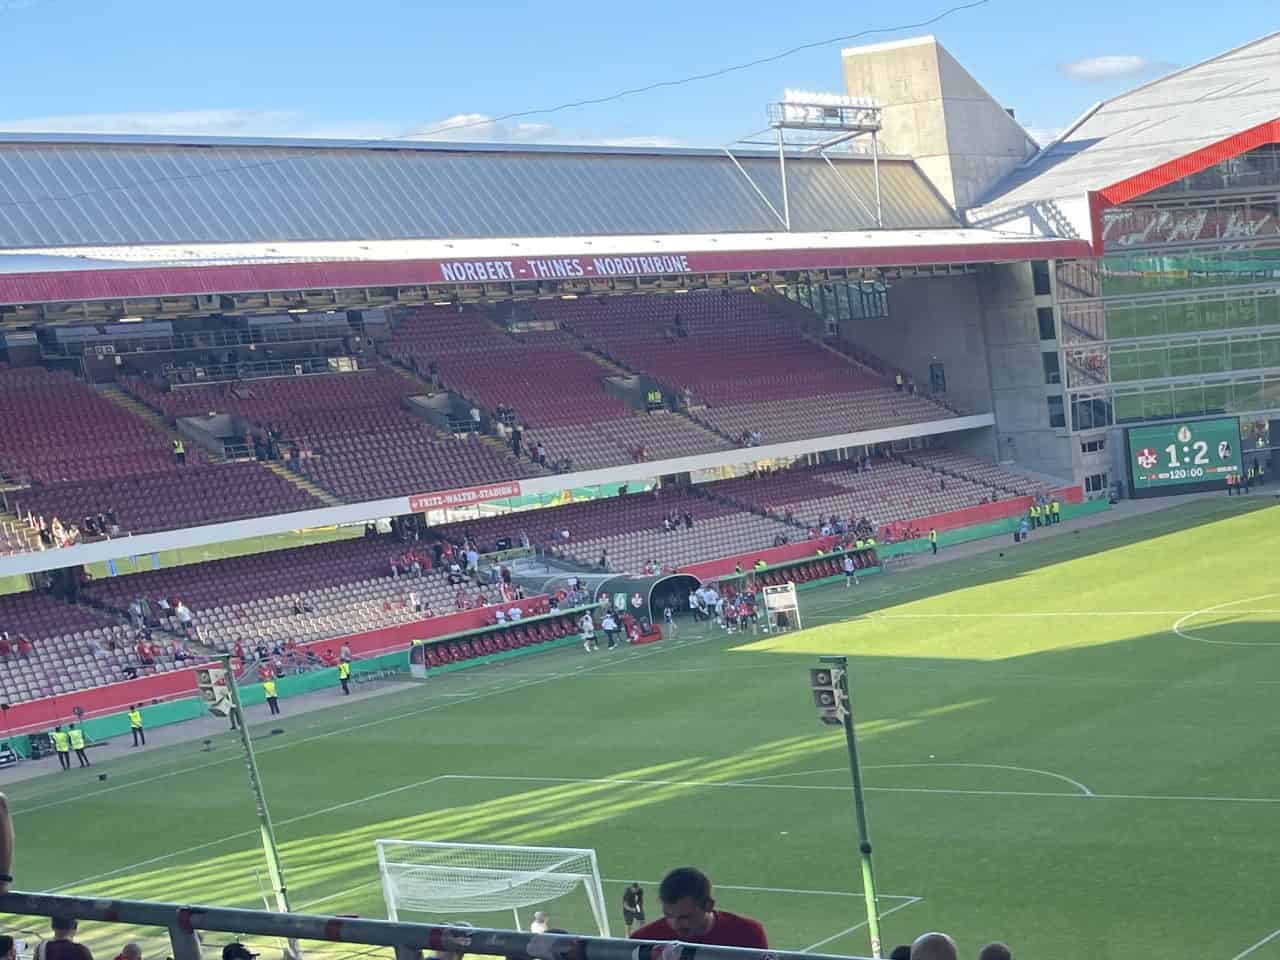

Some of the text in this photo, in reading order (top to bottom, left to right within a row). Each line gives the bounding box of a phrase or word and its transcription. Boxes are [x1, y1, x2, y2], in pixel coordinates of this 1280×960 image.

[441, 261, 515, 281] NORBERT
[528, 258, 584, 278] THINES
[1169, 468, 1203, 480] 120:00
